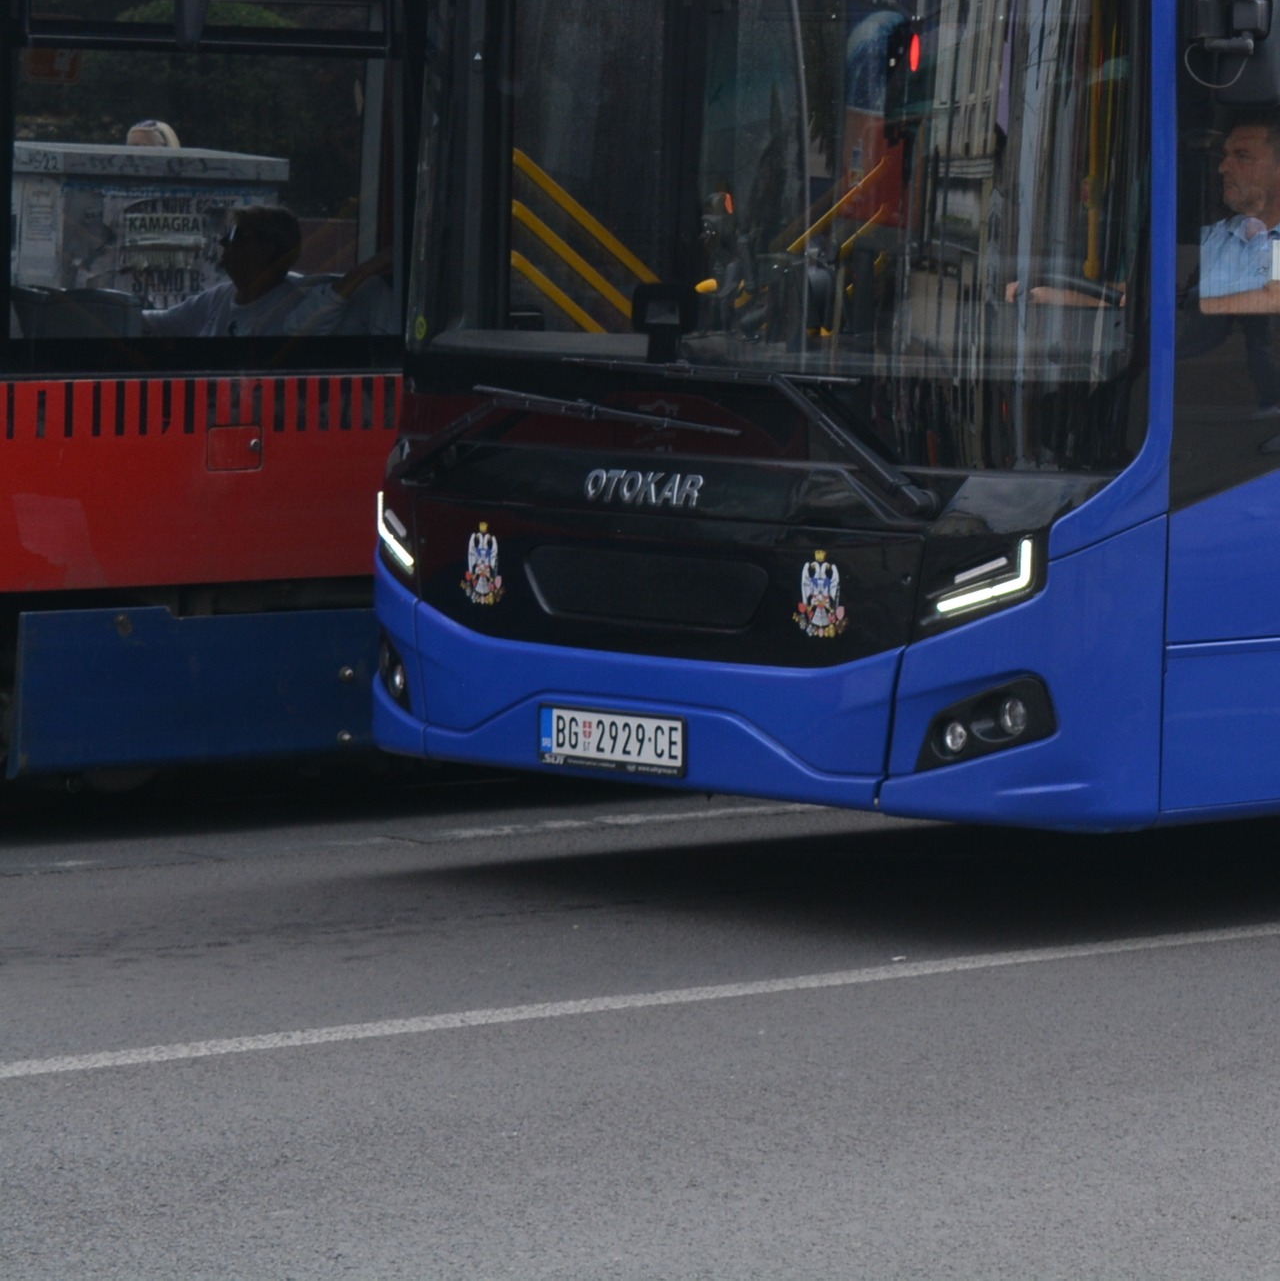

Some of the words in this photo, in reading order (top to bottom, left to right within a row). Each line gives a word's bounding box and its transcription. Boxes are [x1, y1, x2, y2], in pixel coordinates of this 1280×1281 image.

[128, 217, 202, 233] KAMAGRA
[584, 468, 704, 507] OTOKAR
[556, 714, 579, 750] BG
